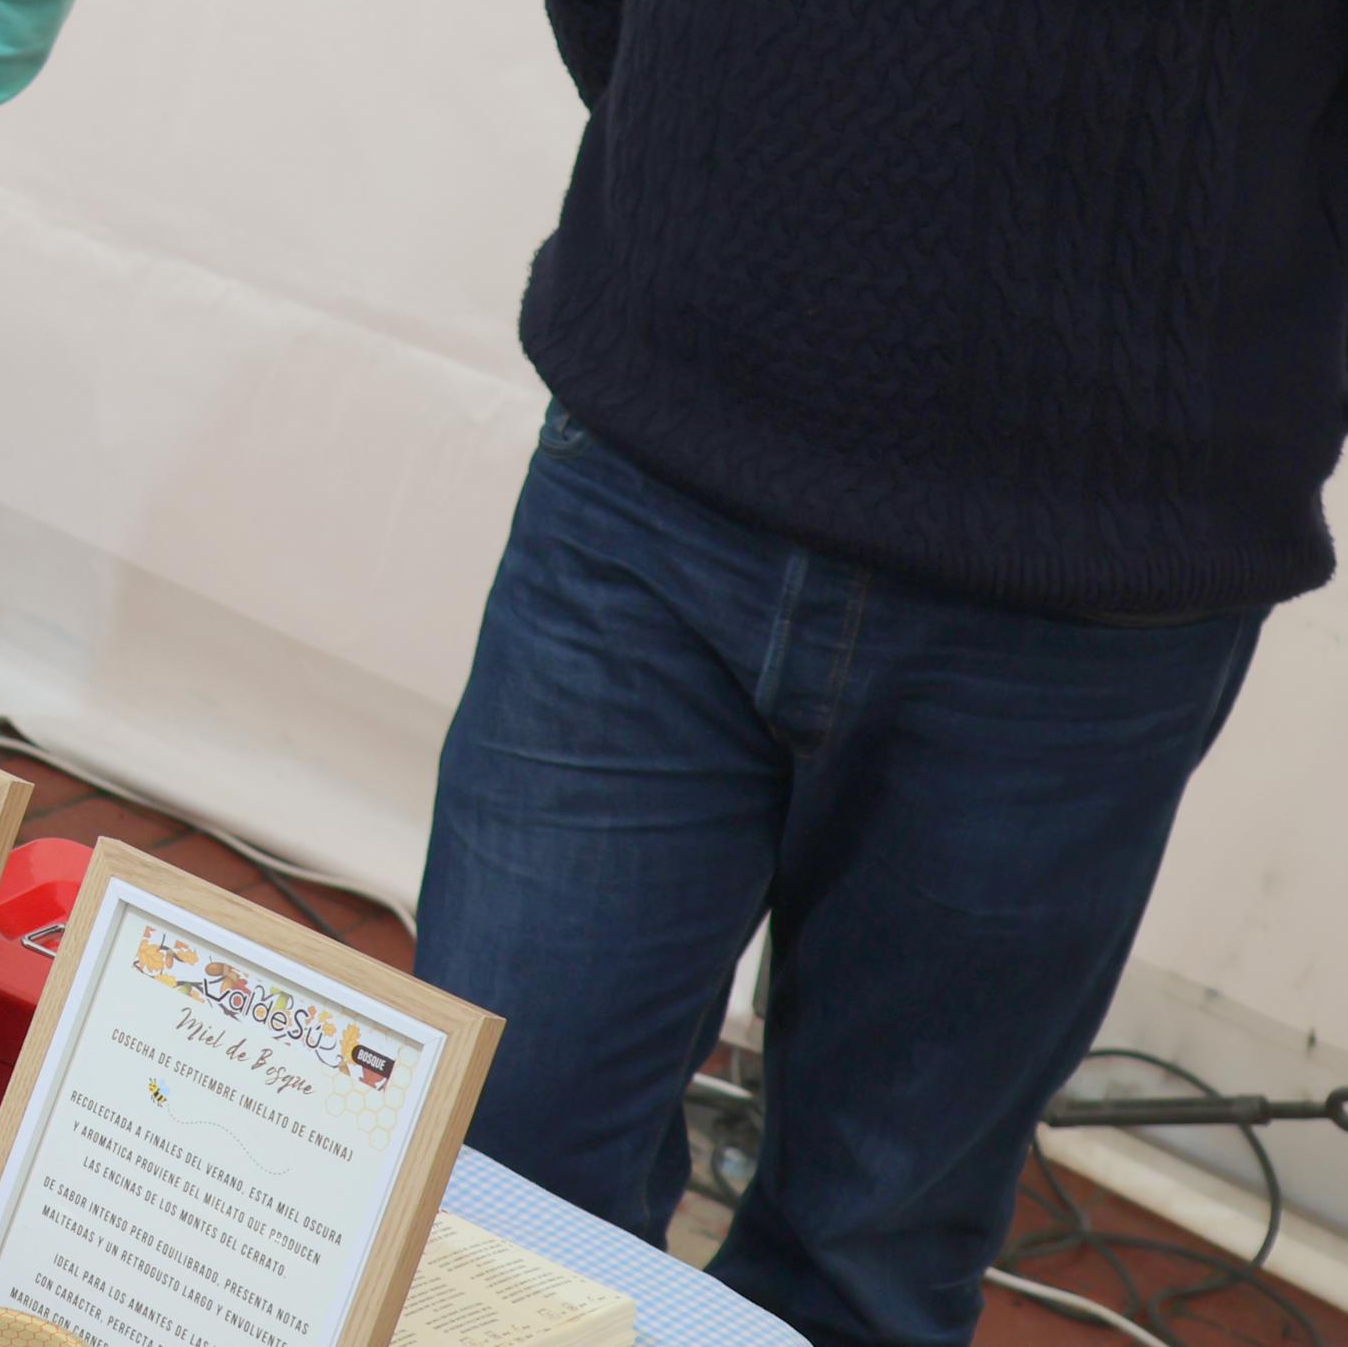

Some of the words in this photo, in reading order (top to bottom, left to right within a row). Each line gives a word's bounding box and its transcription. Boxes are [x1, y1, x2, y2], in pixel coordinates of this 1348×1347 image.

[111, 1028, 155, 1060] COSECHA
[157, 1051, 171, 1068] DE
[173, 1060, 236, 1101] SEPTIEMBRE
[238, 1094, 289, 1128] (MIELATO
[290, 1120, 305, 1137] DE
[307, 1129, 352, 1162] ENCINA)
[174, 1006, 223, 1049] Miel
[225, 1037, 251, 1063] de
[250, 1048, 319, 1095] Bosque
[357, 1048, 387, 1072] BOSQUE
[70, 1090, 132, 1132] RECOLECTADA
[134, 1125, 141, 1137] A
[143, 1130, 183, 1159] FINALES
[184, 1152, 201, 1170] DEL
[248, 1186, 273, 1209] ESTA
[275, 1201, 299, 1223] MIEL
[302, 1215, 342, 1245] OSCURA
[73, 1120, 79, 1131] Y
[80, 1125, 132, 1162] AROMÁTICA
[134, 1154, 181, 1188] PROVIENE
[182, 1180, 199, 1199] DEL
[202, 1192, 245, 1223] MIELATO
[246, 1216, 266, 1235] QUE
[82, 1155, 101, 1173] LAS
[102, 1166, 142, 1196] ENCINAS
[144, 1189, 157, 1205] DE
[158, 1197, 177, 1216] LOS
[178, 1208, 218, 1238] MONTES
[219, 1231, 237, 1250] DEL
[34, 1272, 53, 1291] CON
[41, 1204, 95, 1243] MALTEADAS
[97, 1235, 104, 1247] Y
[105, 1241, 118, 1256] UN
[120, 1249, 180, 1292] RETROGUSTO
[181, 1285, 213, 1311] LARGO
[216, 1303, 223, 1316] Y
[43, 1175, 56, 1190] DE
[56, 1183, 87, 1209] SABOR
[88, 1201, 128, 1231] INTENSO
[129, 1224, 154, 1246] PERO
[223, 1278, 273, 1315] PRESENTA
[275, 1308, 308, 1335] NOTAS
[53, 1253, 79, 1277] IDEAL
[81, 1270, 105, 1292] PARA
[107, 1286, 126, 1304] LOS
[127, 1297, 173, 1331] AMANTES
[174, 1324, 188, 1340] DE
[9, 1286, 50, 1317] MARIDAR
[51, 1312, 70, 1329] CON
